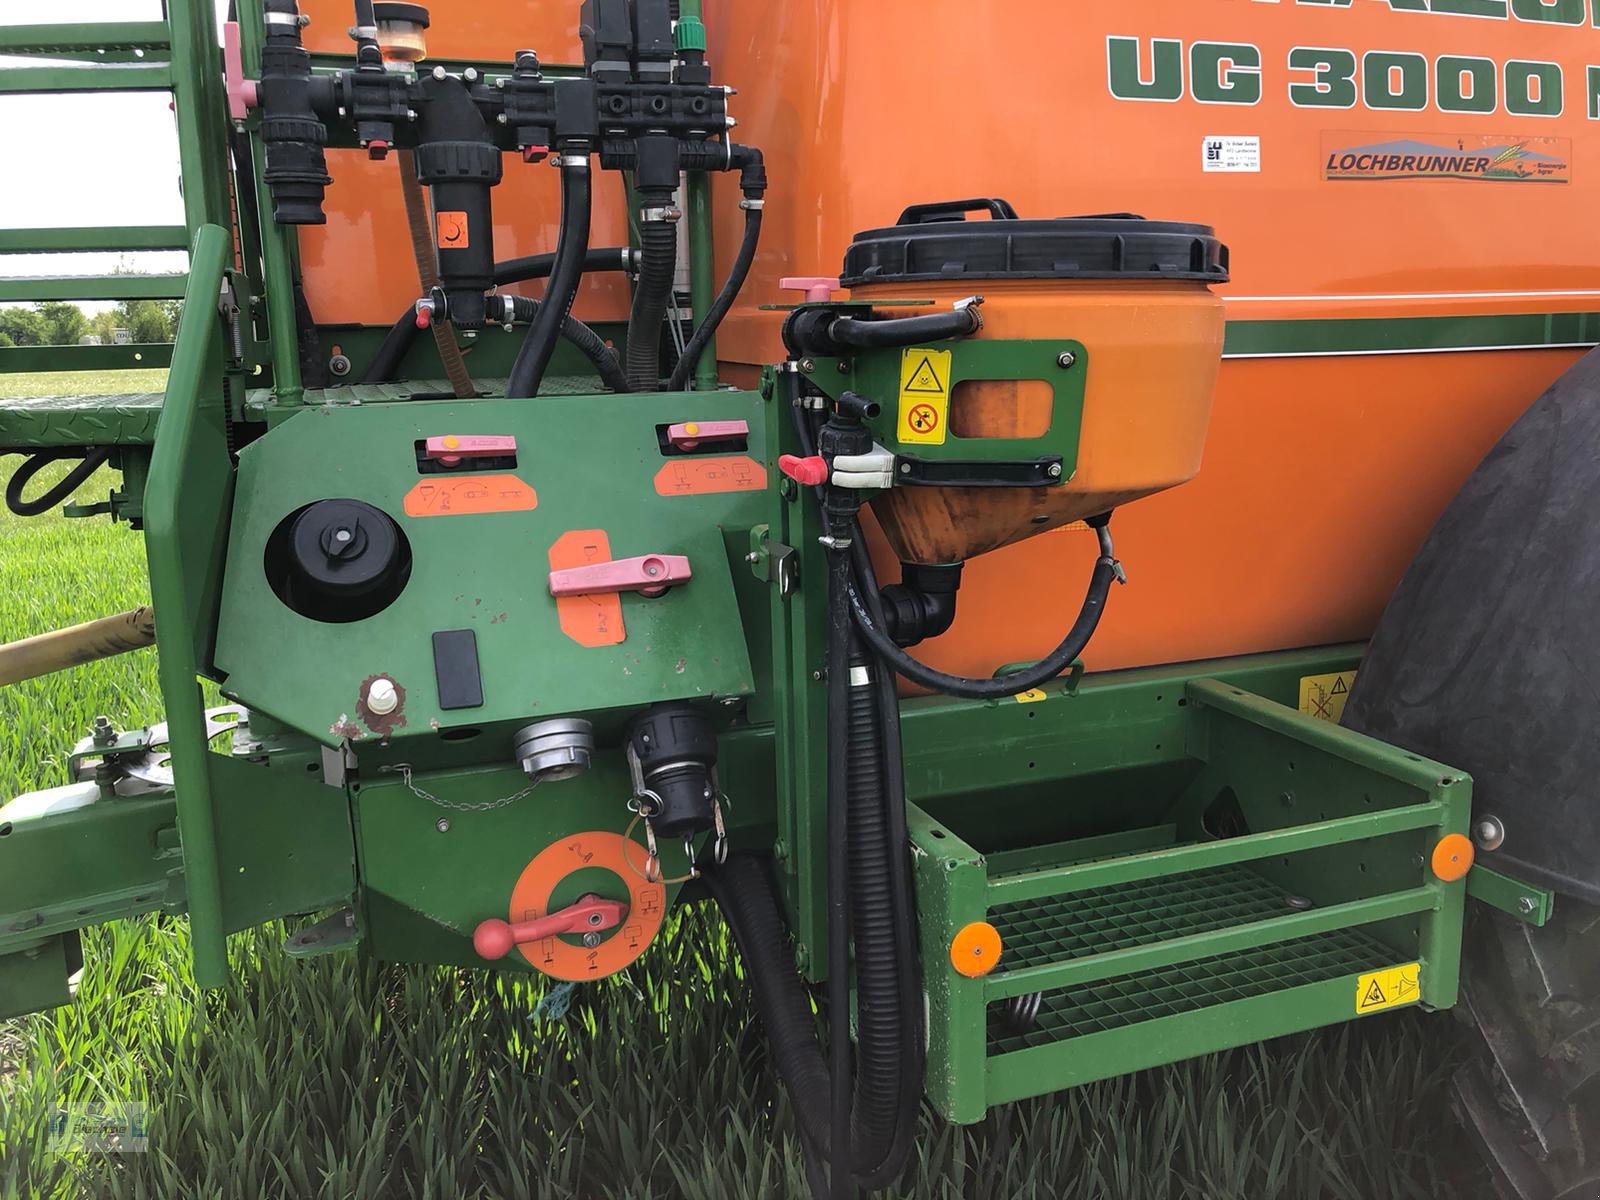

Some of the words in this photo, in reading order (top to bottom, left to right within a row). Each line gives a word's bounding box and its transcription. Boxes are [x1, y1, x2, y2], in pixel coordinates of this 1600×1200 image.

[1106, 35, 1261, 105] UG
[1288, 46, 1564, 117] 3000
[1326, 153, 1490, 173] LOCHBRUNNER
